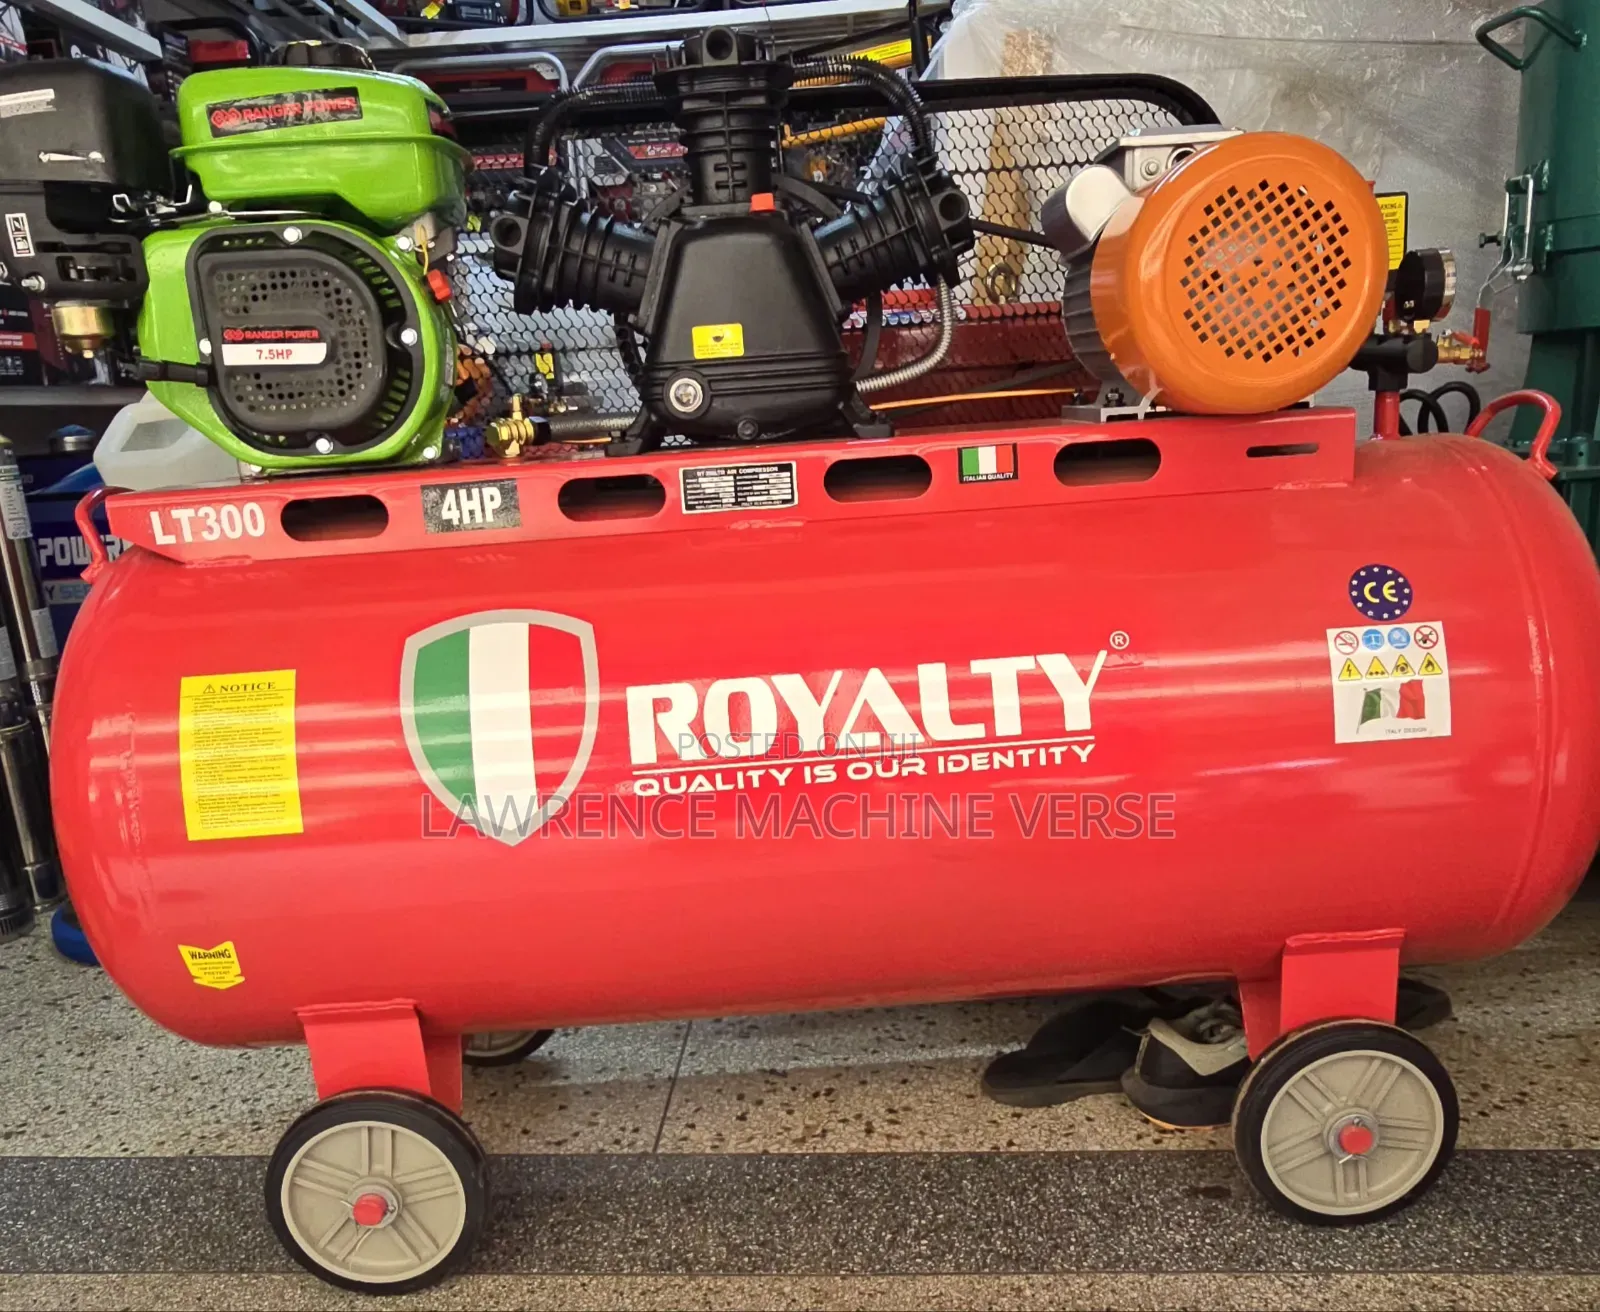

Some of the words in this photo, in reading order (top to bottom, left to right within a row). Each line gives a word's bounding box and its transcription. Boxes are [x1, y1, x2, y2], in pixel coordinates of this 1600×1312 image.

[242, 102, 302, 121] RANGER
[303, 96, 357, 113] POWER
[244, 330, 284, 339] RANGER
[285, 329, 319, 338] POWER
[256, 349, 293, 360] 7.5HP
[440, 486, 502, 526] 4HP
[149, 502, 266, 545] LT300
[38, 533, 134, 567] POWR
[1363, 581, 1399, 603] CE
[220, 682, 276, 693] NOTICE
[626, 650, 1108, 765] ROYALTY
[633, 767, 793, 796] QUALITY
[804, 764, 838, 784] IS
[847, 757, 927, 781] OUR
[938, 744, 1096, 774] IDENTITY
[188, 949, 231, 960] WARNING
